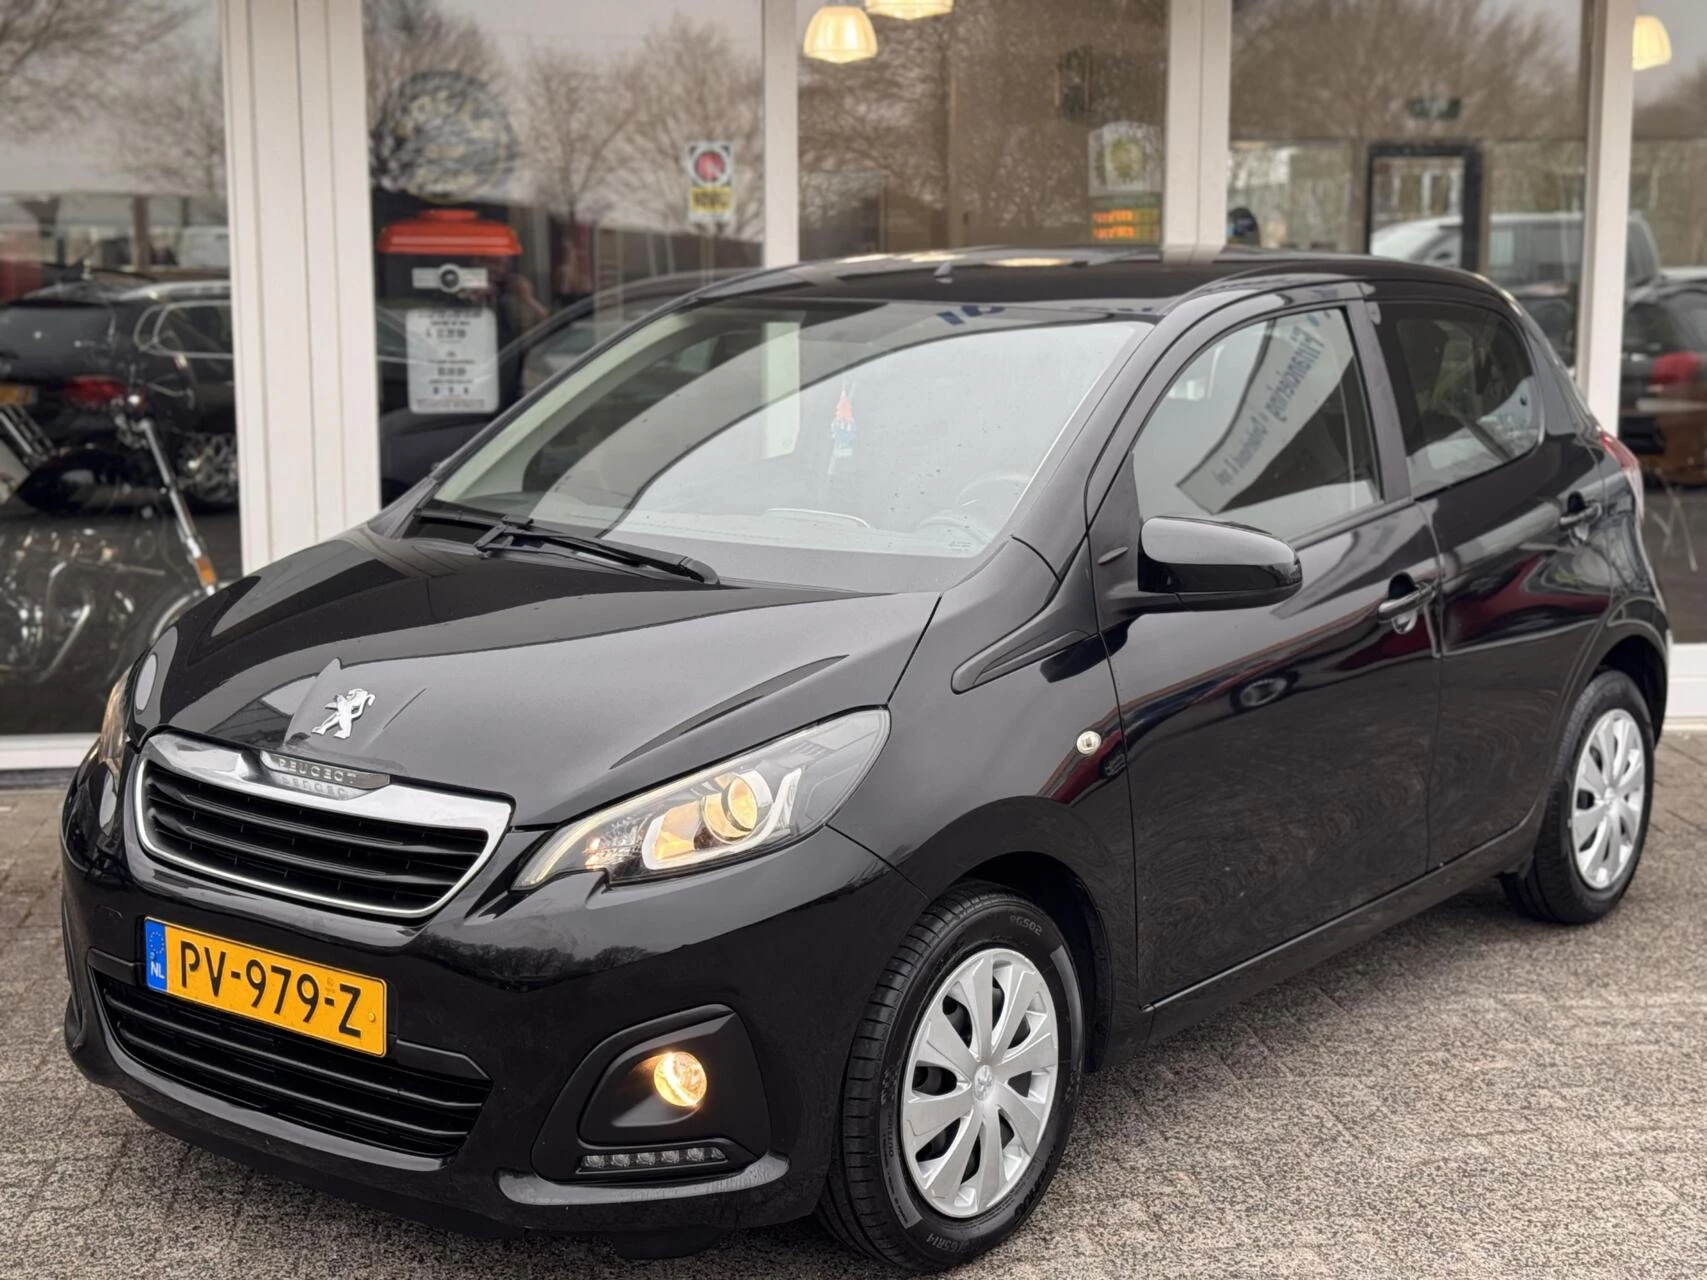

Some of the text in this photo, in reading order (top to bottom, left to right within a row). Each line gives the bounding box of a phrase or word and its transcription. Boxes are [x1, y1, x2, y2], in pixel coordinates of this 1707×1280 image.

[278, 758, 357, 784] PEUGEOT
[150, 960, 165, 979] NL
[181, 941, 362, 1038] PV-979-Z
